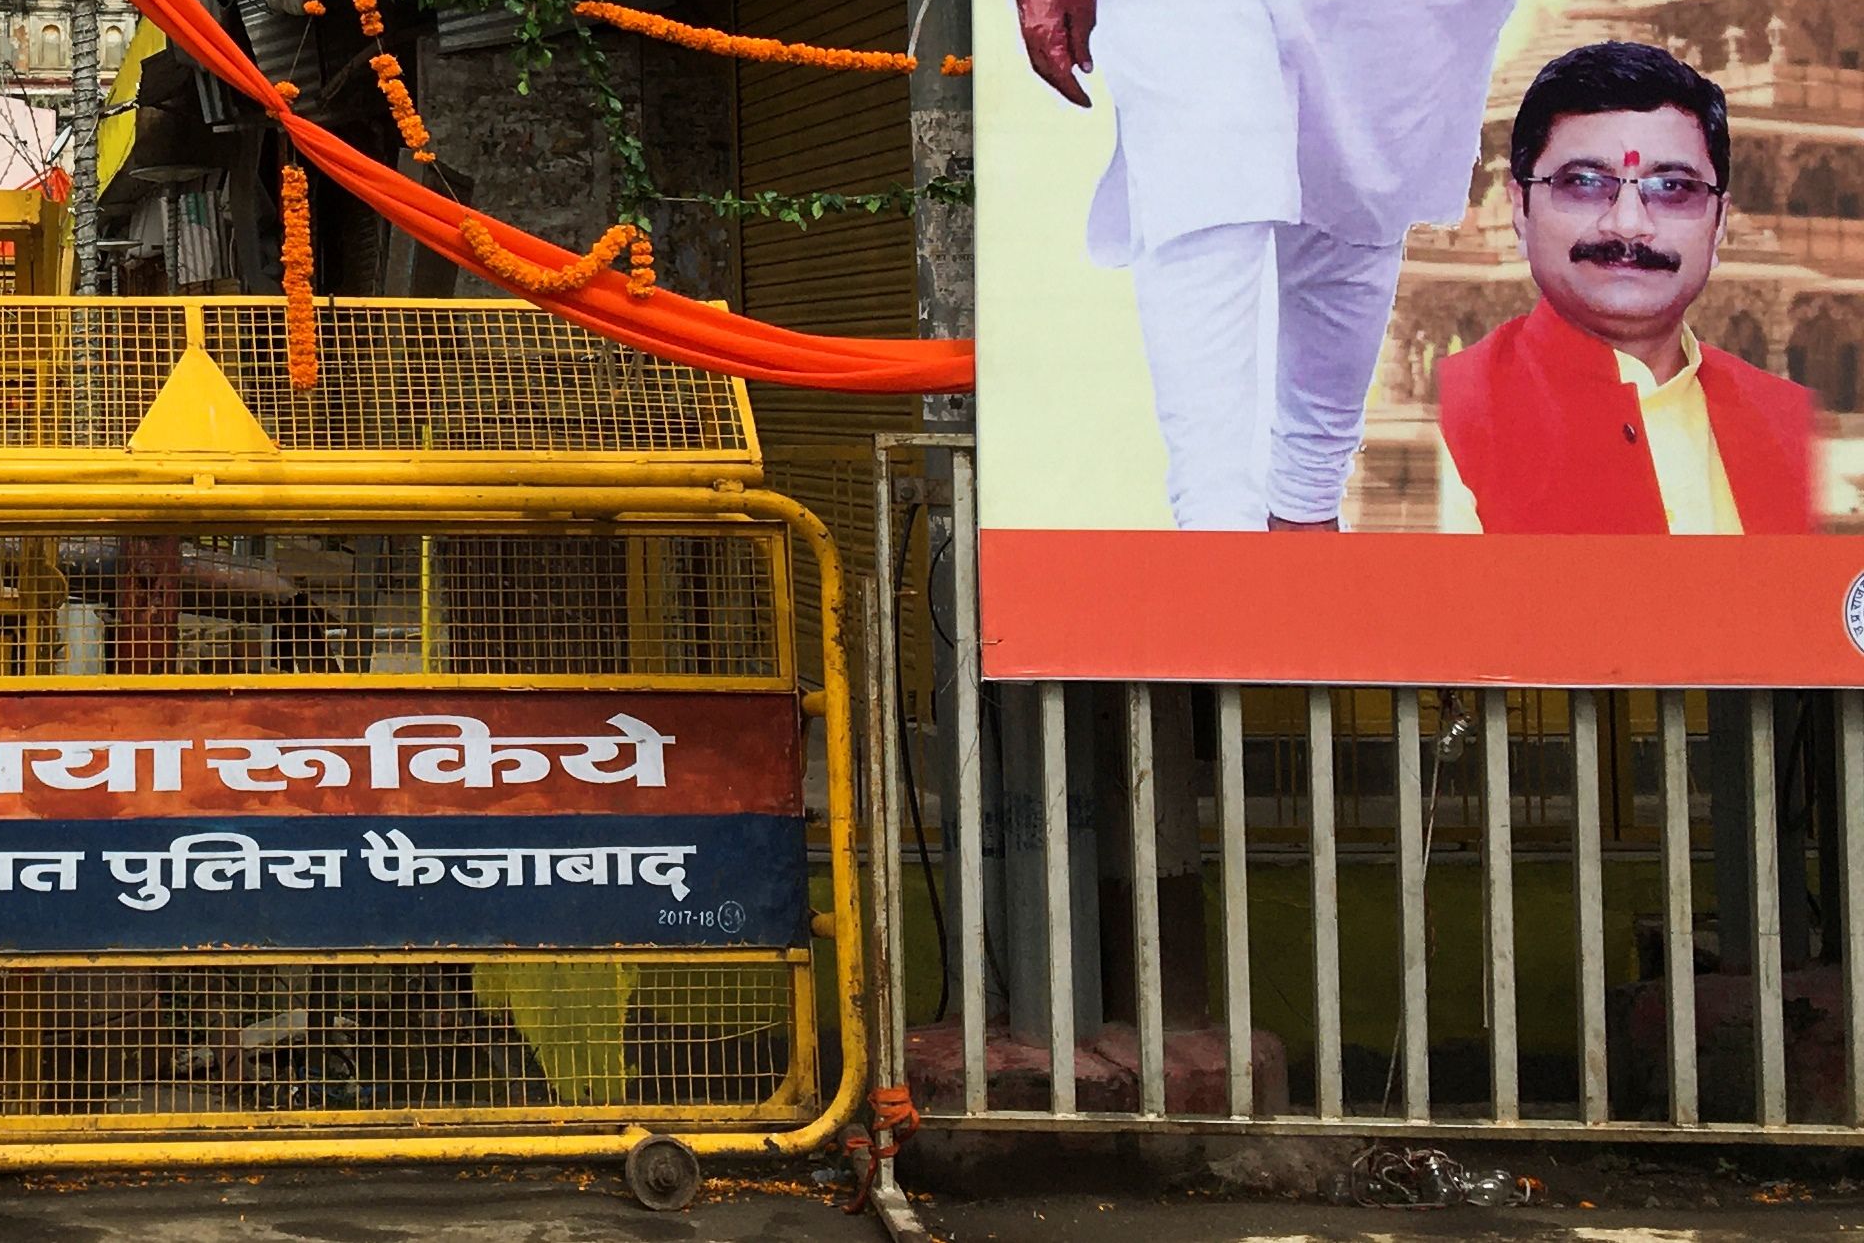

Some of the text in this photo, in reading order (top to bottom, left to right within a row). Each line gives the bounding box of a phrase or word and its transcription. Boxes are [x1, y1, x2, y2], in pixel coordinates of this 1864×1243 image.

[102, 831, 348, 911] पुलिस
[361, 829, 697, 901] फैजाबाद
[658, 909, 715, 928] 2017-18
